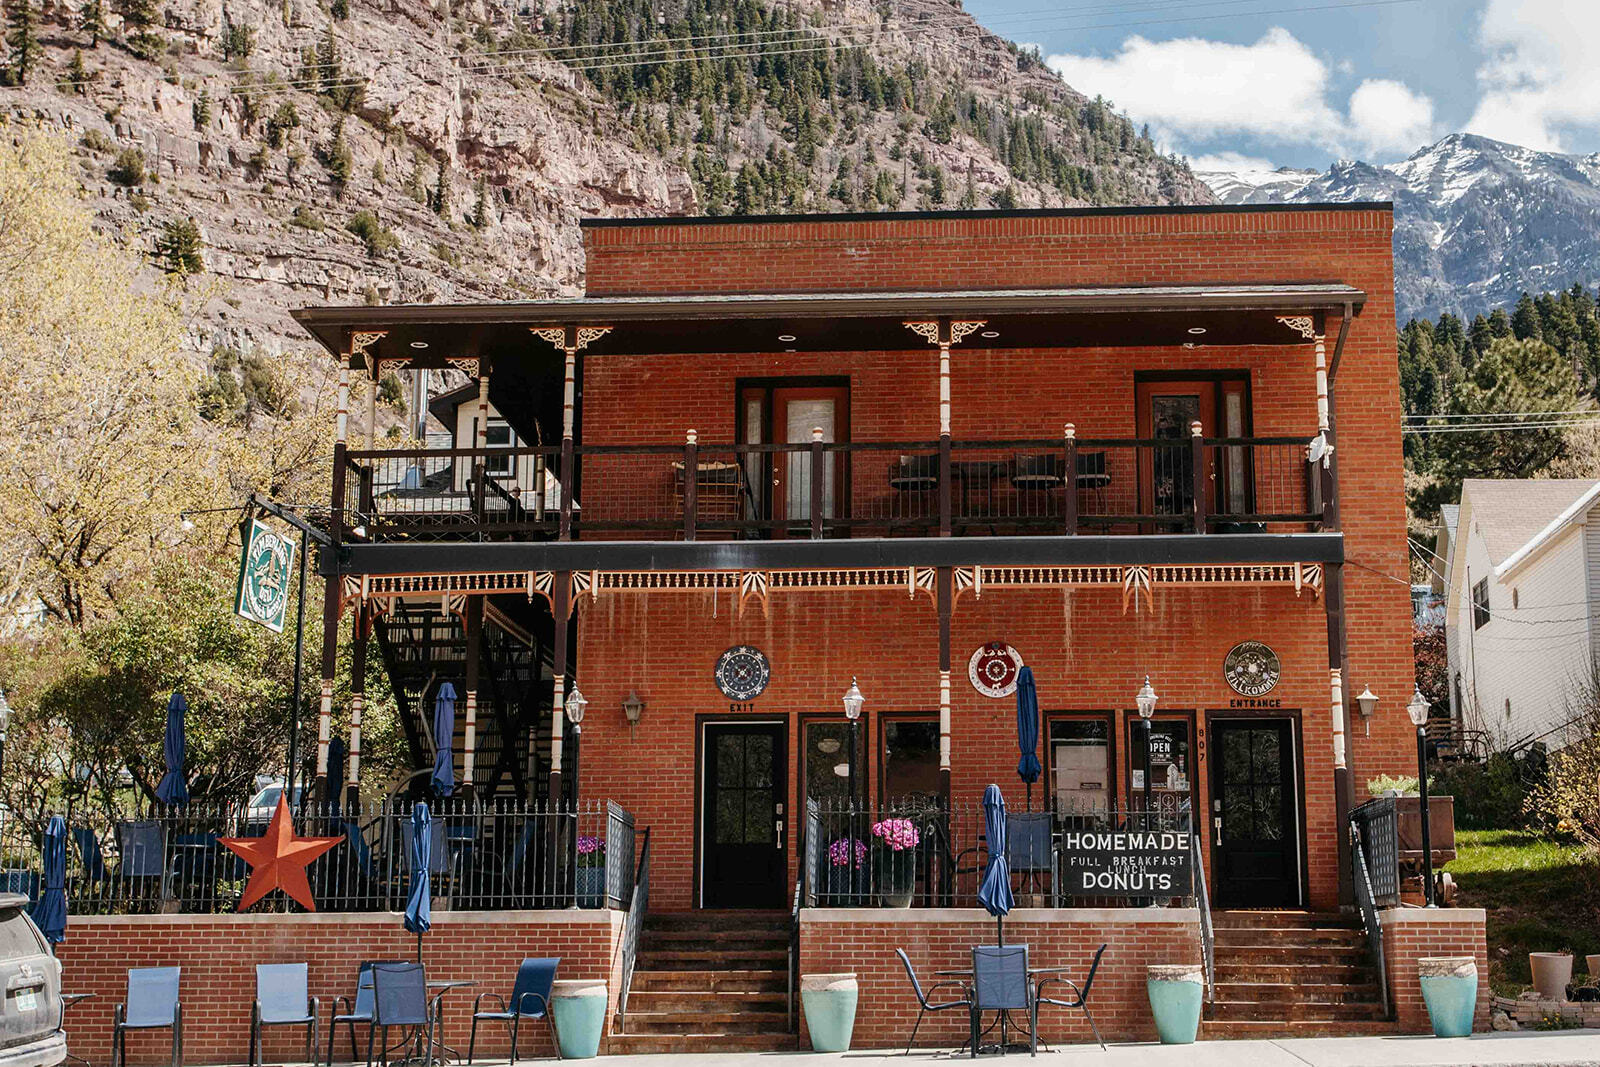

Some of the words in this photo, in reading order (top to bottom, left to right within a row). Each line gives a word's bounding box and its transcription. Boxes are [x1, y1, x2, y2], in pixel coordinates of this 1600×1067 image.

[1227, 670, 1279, 695] WILLKOMMEN
[730, 703, 754, 712] EXIT
[1230, 699, 1281, 708] ENTRANCE
[1066, 832, 1189, 850] HOMEMADE
[1070, 857, 1101, 866] FULL
[1113, 856, 1184, 866] BREAKFAST
[1108, 865, 1146, 874] LUNCH
[1082, 872, 1171, 890] DONUTS
